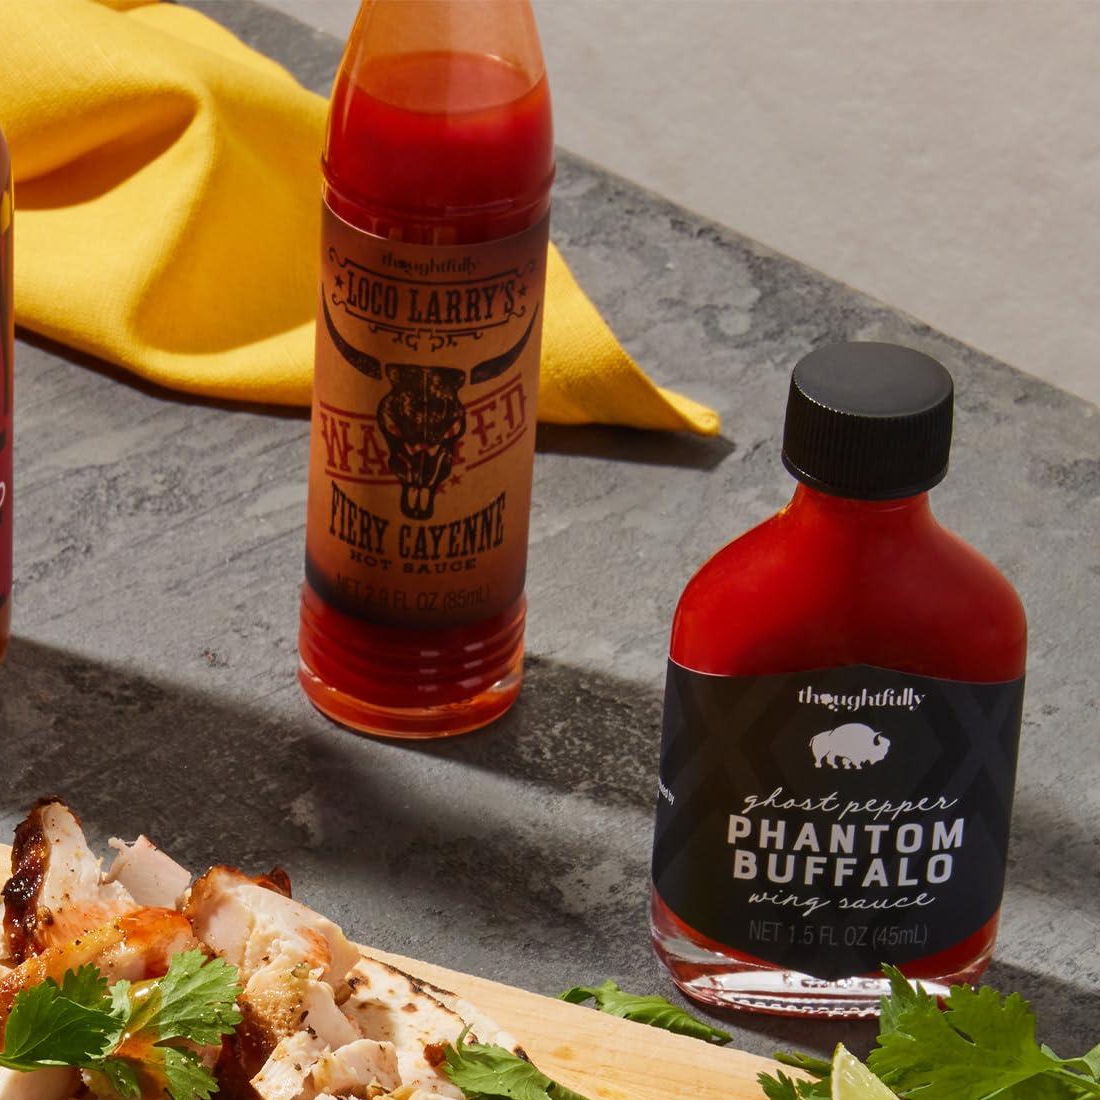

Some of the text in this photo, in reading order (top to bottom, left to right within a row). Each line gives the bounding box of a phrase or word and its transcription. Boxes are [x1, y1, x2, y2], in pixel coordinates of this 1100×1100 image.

[381, 251, 481, 277] thoughtfully
[345, 273, 518, 325] LOCO LARRY'S
[319, 382, 527, 475] WAED
[329, 480, 506, 560] FIERY CAYENNE
[350, 550, 477, 575] HOT SAUCE
[394, 589, 408, 609] FL
[416, 591, 438, 610] OZ
[798, 686, 926, 712] thoughtfully
[741, 786, 958, 820] ghost pepper
[727, 814, 964, 854] PHANTOM
[733, 849, 953, 888] BUFFALO
[748, 889, 935, 917] wing sauce
[750, 920, 928, 948] NET 1.5 FL OZ (45mL)
